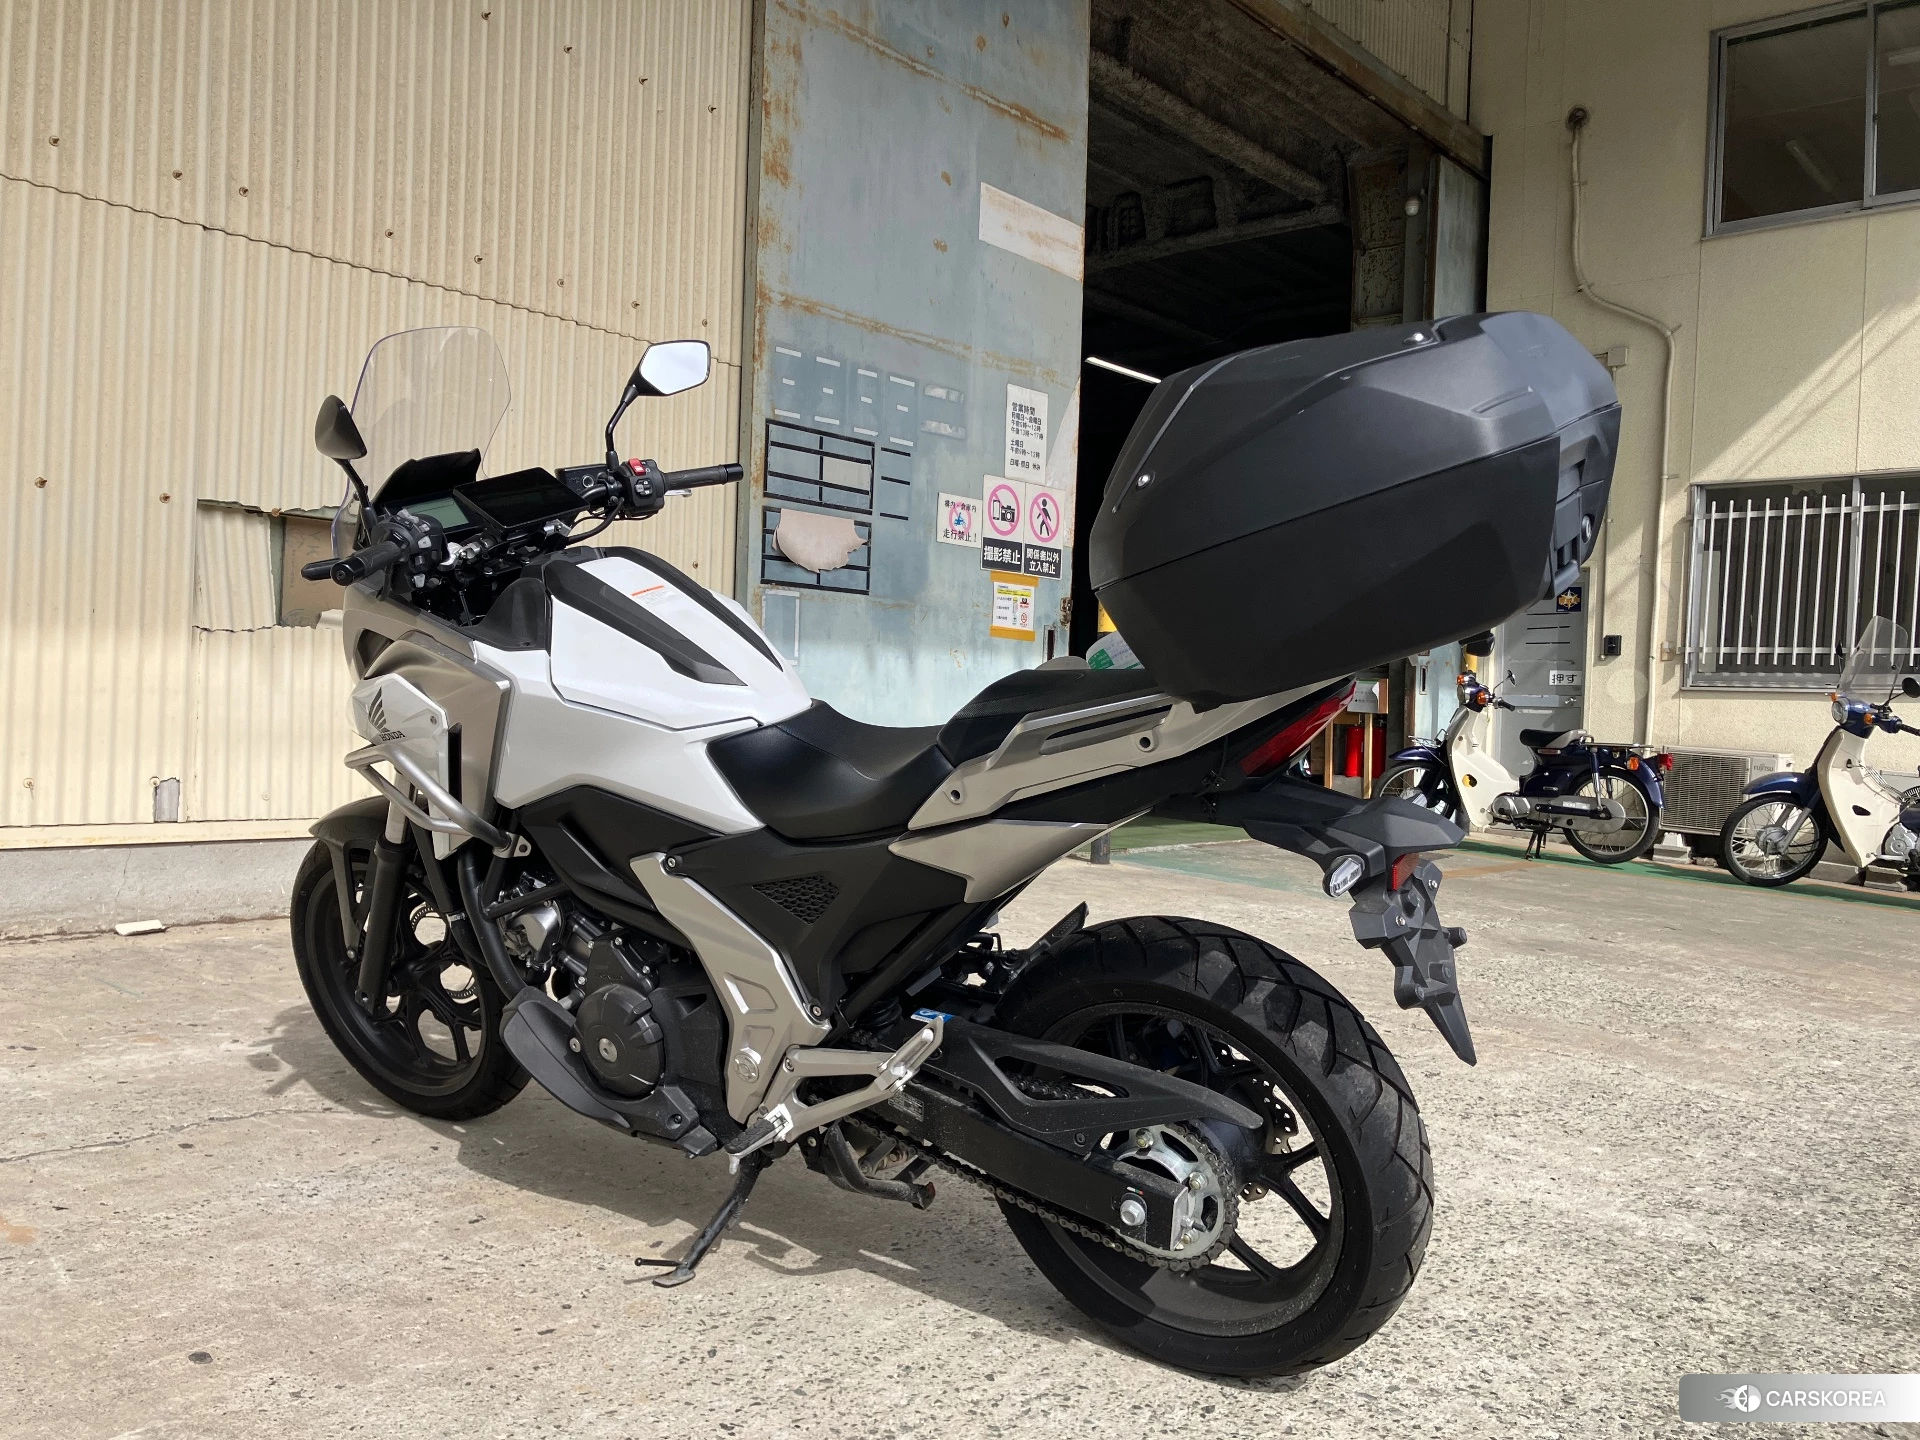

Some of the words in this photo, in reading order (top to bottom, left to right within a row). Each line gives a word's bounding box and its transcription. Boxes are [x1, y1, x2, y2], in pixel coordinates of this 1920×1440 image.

[1012, 402, 1035, 416] 営業時間
[1010, 440, 1023, 448] 土曜日
[984, 545, 1020, 565] 撮影禁止
[1026, 547, 1060, 563] 関係者以外
[1029, 561, 1056, 575] 立入禁止
[1551, 673, 1578, 683] 押す
[379, 730, 406, 741] HONDA
